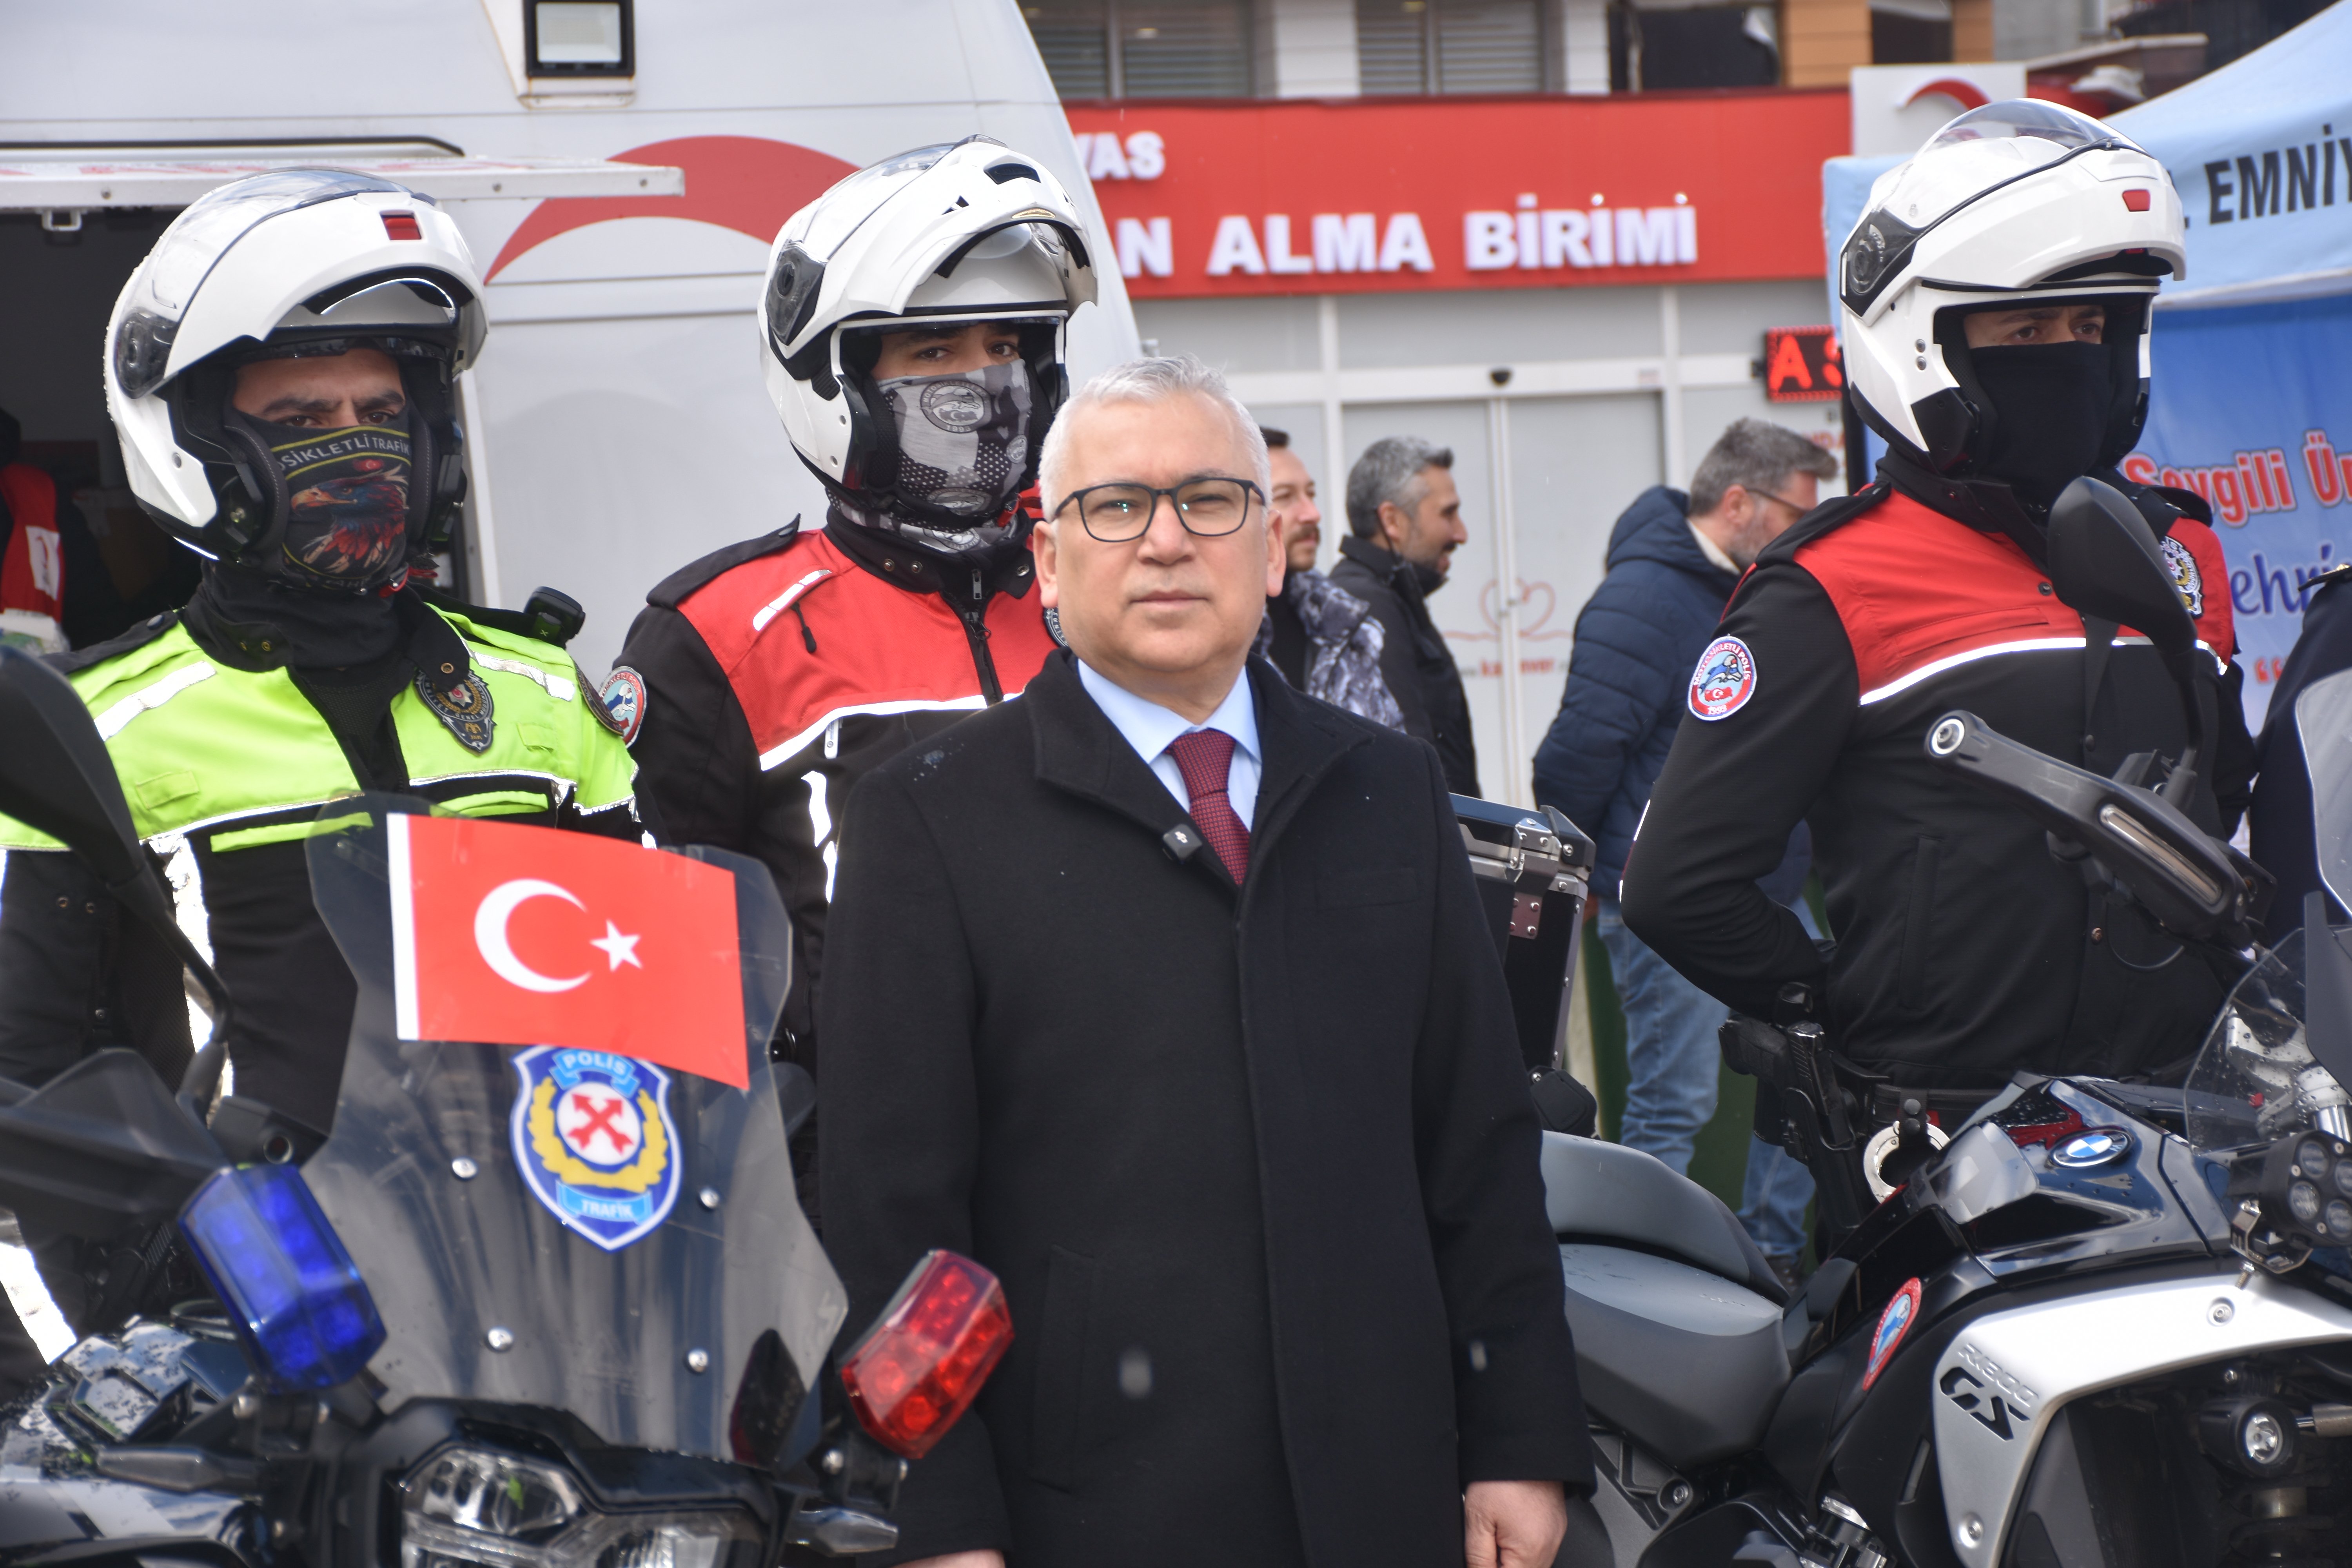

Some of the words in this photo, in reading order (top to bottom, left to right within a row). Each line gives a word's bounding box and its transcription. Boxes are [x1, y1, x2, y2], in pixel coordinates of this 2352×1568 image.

[1207, 214, 1434, 274] ALMA
[1465, 193, 1698, 270] BİRİMİ
[371, 437, 410, 456] TRAFİK
[581, 1199, 634, 1218] TRAFİK
[1939, 1367, 2031, 1441] GS
